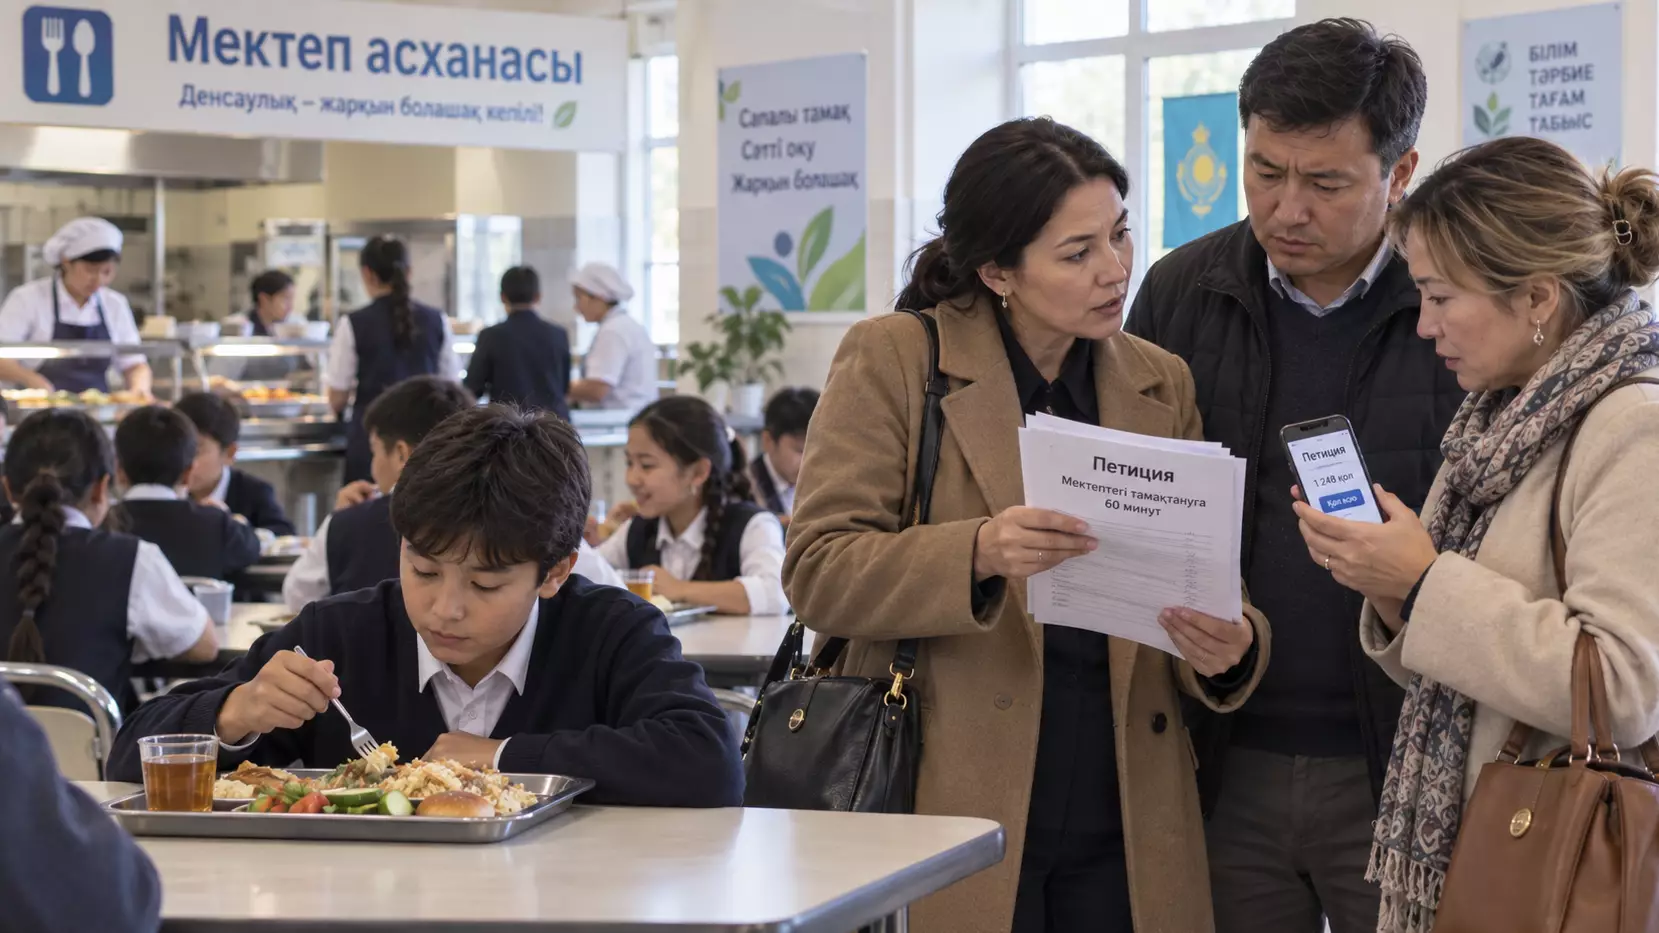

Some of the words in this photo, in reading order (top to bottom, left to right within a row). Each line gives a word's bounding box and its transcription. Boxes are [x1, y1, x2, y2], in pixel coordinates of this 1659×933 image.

[168, 13, 351, 72] Мектеп
[366, 37, 582, 84] асханасы
[1529, 41, 1578, 62] БІЛІМ
[1528, 63, 1594, 86] ТӘРБИЕ
[179, 83, 298, 114] Денсаулық
[739, 107, 798, 129] Сапалы
[803, 103, 851, 124] тамақ
[1528, 113, 1593, 133] ТАБЫС
[1302, 446, 1346, 462] Петиция
[1093, 456, 1174, 483] Петиция
[1061, 475, 1128, 498] Мектептегі
[1104, 498, 1120, 510] 60
[1123, 502, 1161, 517] минут
